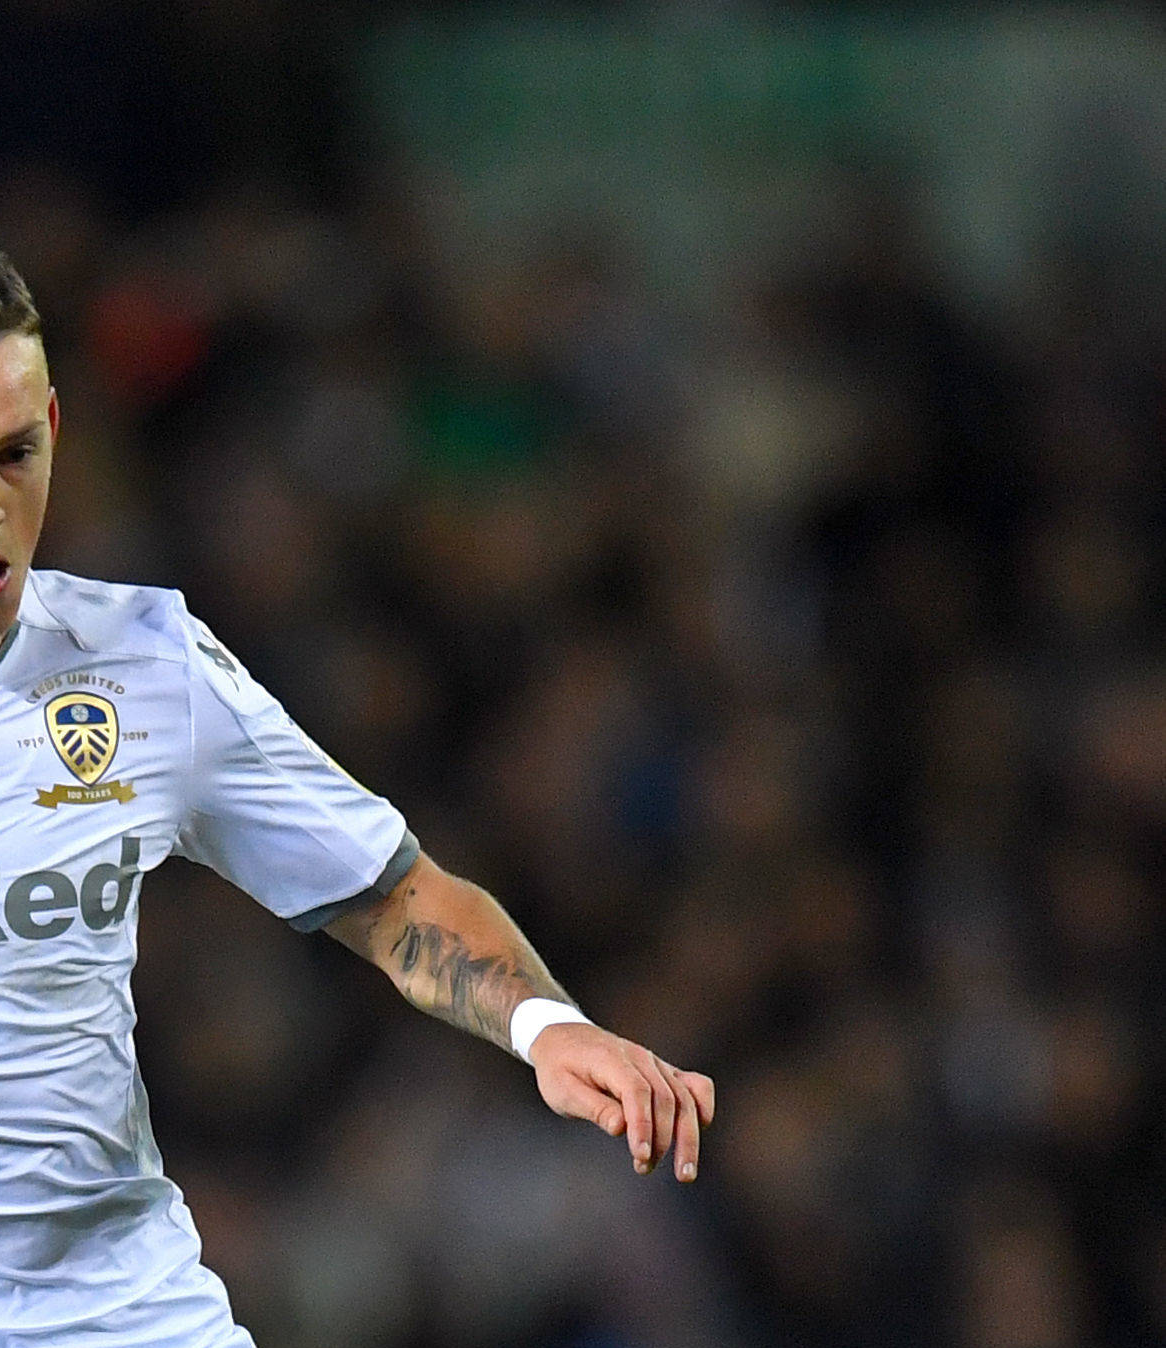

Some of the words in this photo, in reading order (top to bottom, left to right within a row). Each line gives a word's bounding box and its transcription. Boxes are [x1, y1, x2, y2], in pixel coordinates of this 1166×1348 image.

[67, 673, 125, 695] UNITED
[121, 731, 148, 742] 2019
[17, 737, 45, 748] 1919
[67, 790, 82, 800] 100
[85, 788, 111, 799] YEARS
